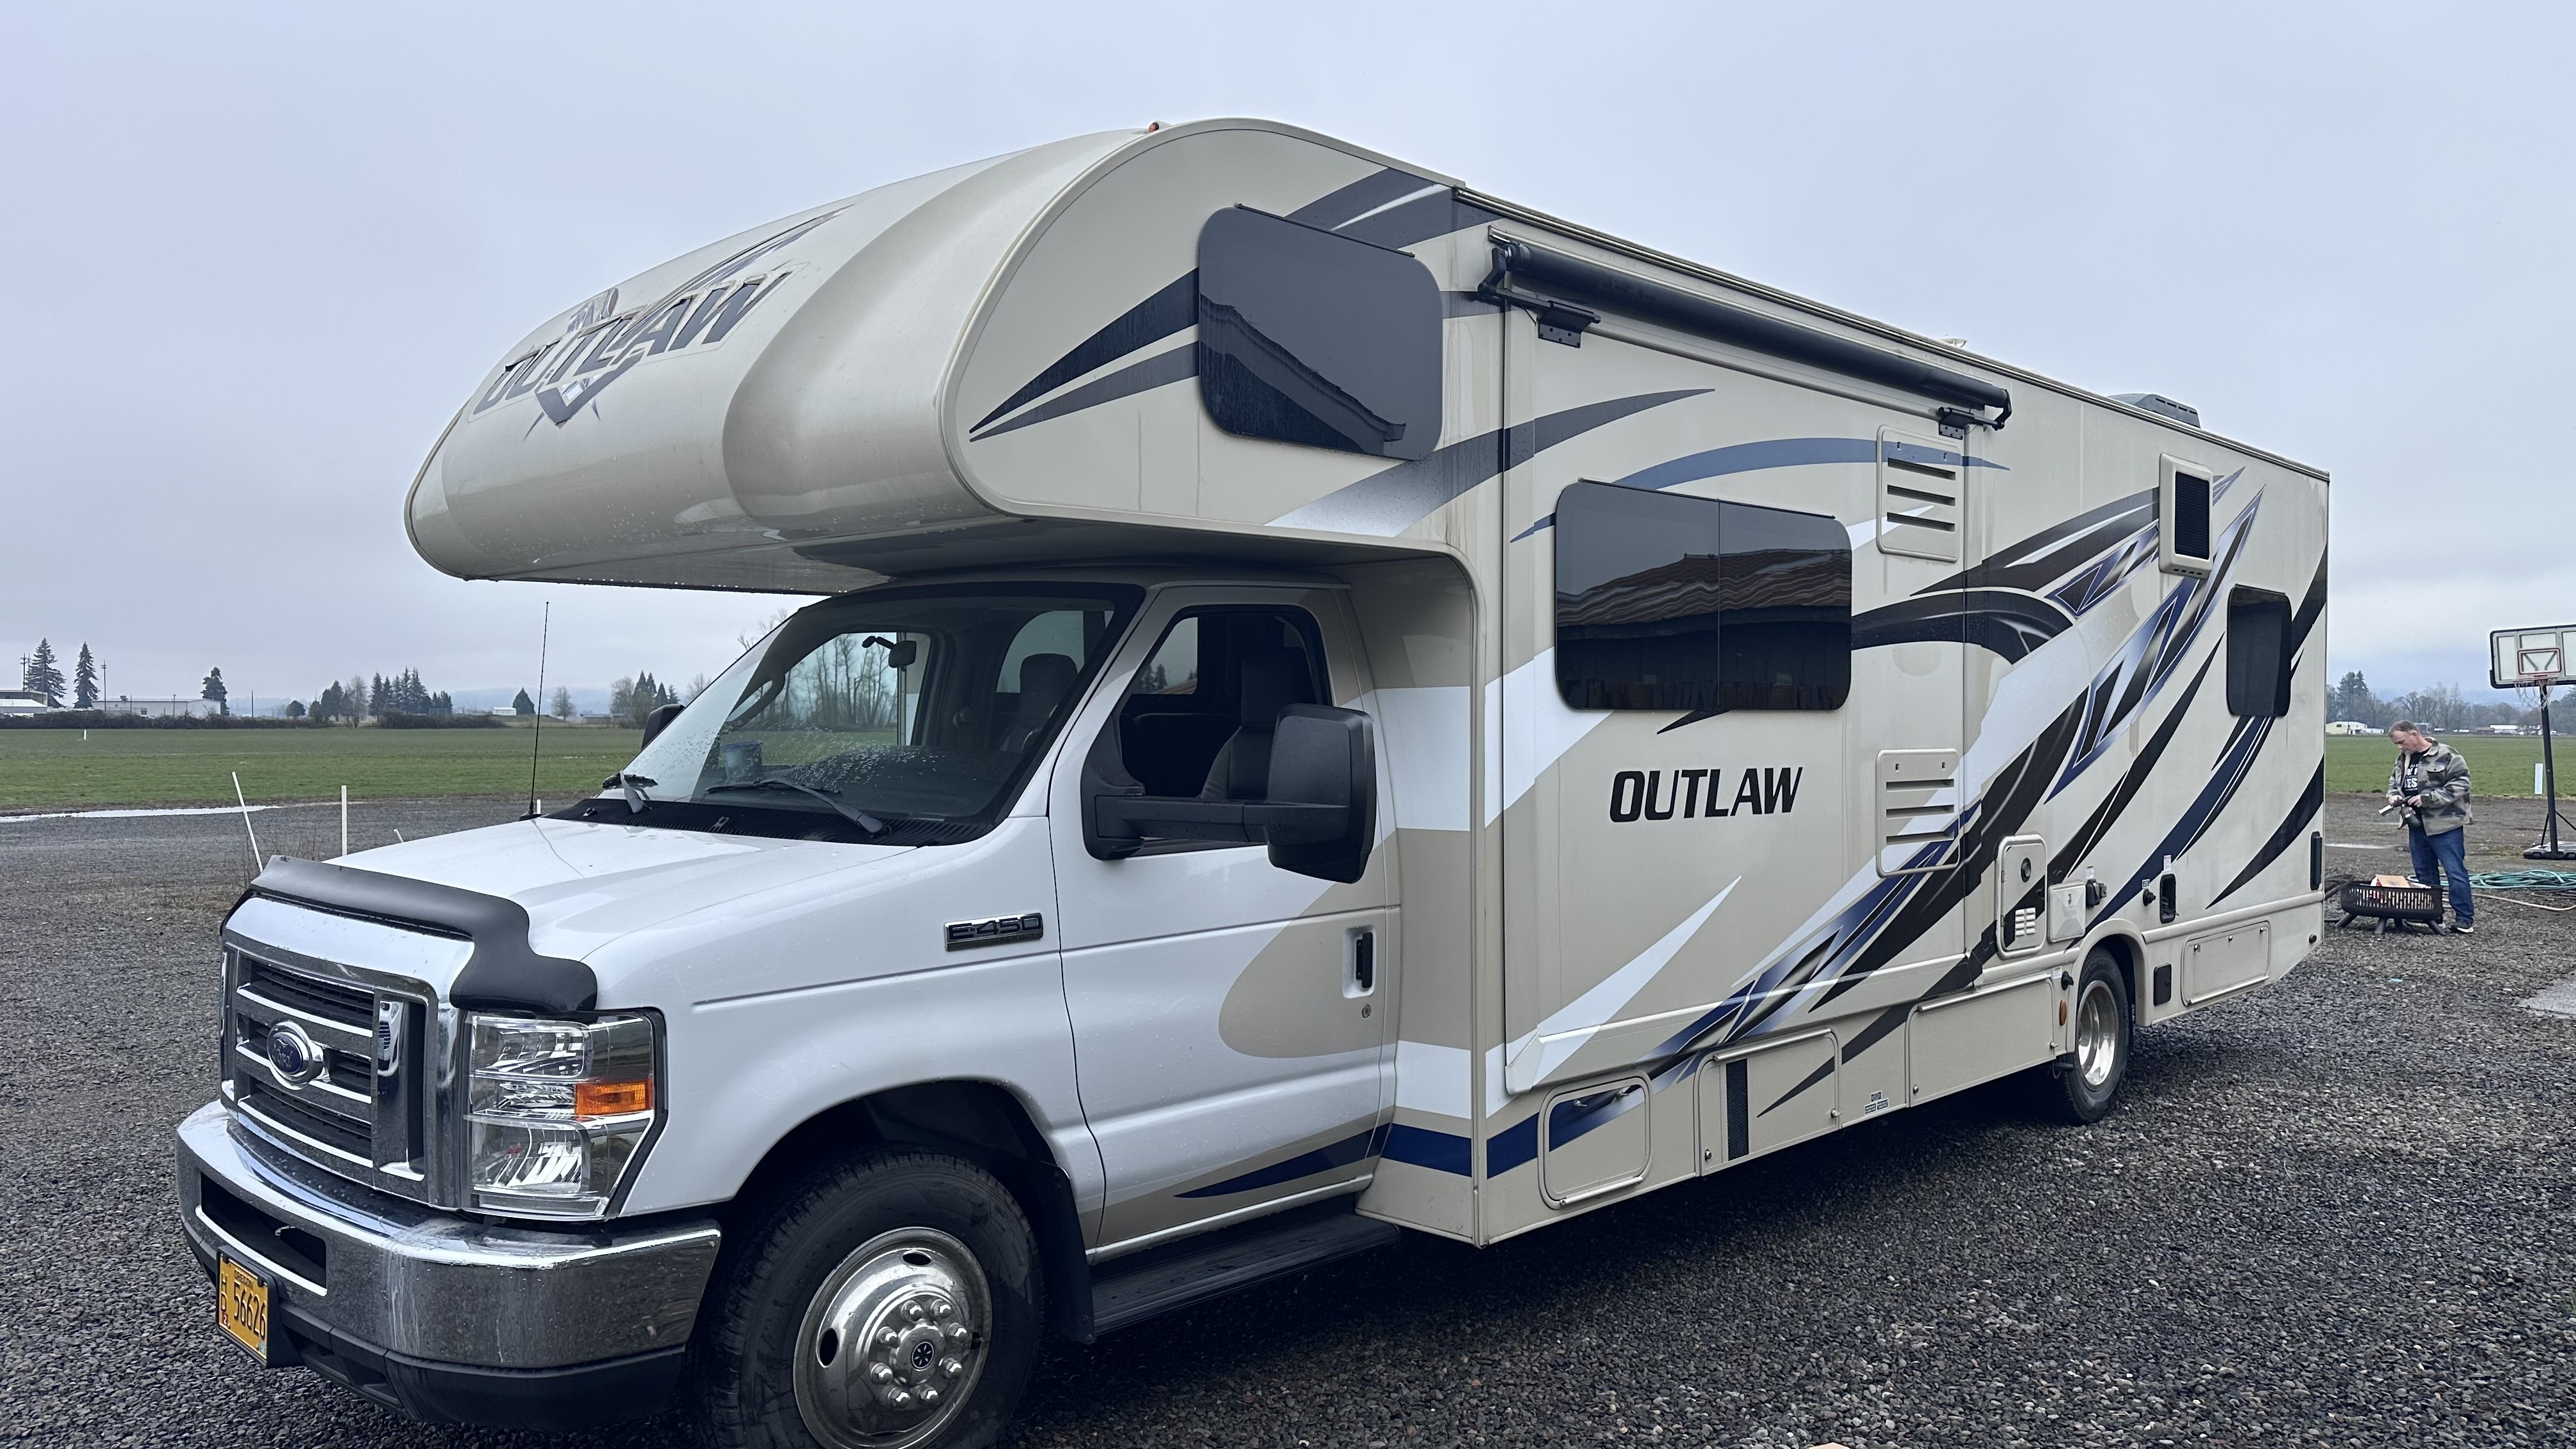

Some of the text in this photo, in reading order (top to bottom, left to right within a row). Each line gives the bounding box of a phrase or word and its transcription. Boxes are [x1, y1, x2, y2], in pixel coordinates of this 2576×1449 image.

[472, 270, 793, 415] OUTLAW
[1609, 767, 1803, 823] OUTLAW
[949, 915, 1042, 940] E-450
[272, 1038, 294, 1068] Ford
[234, 1280, 266, 1340] 56626
